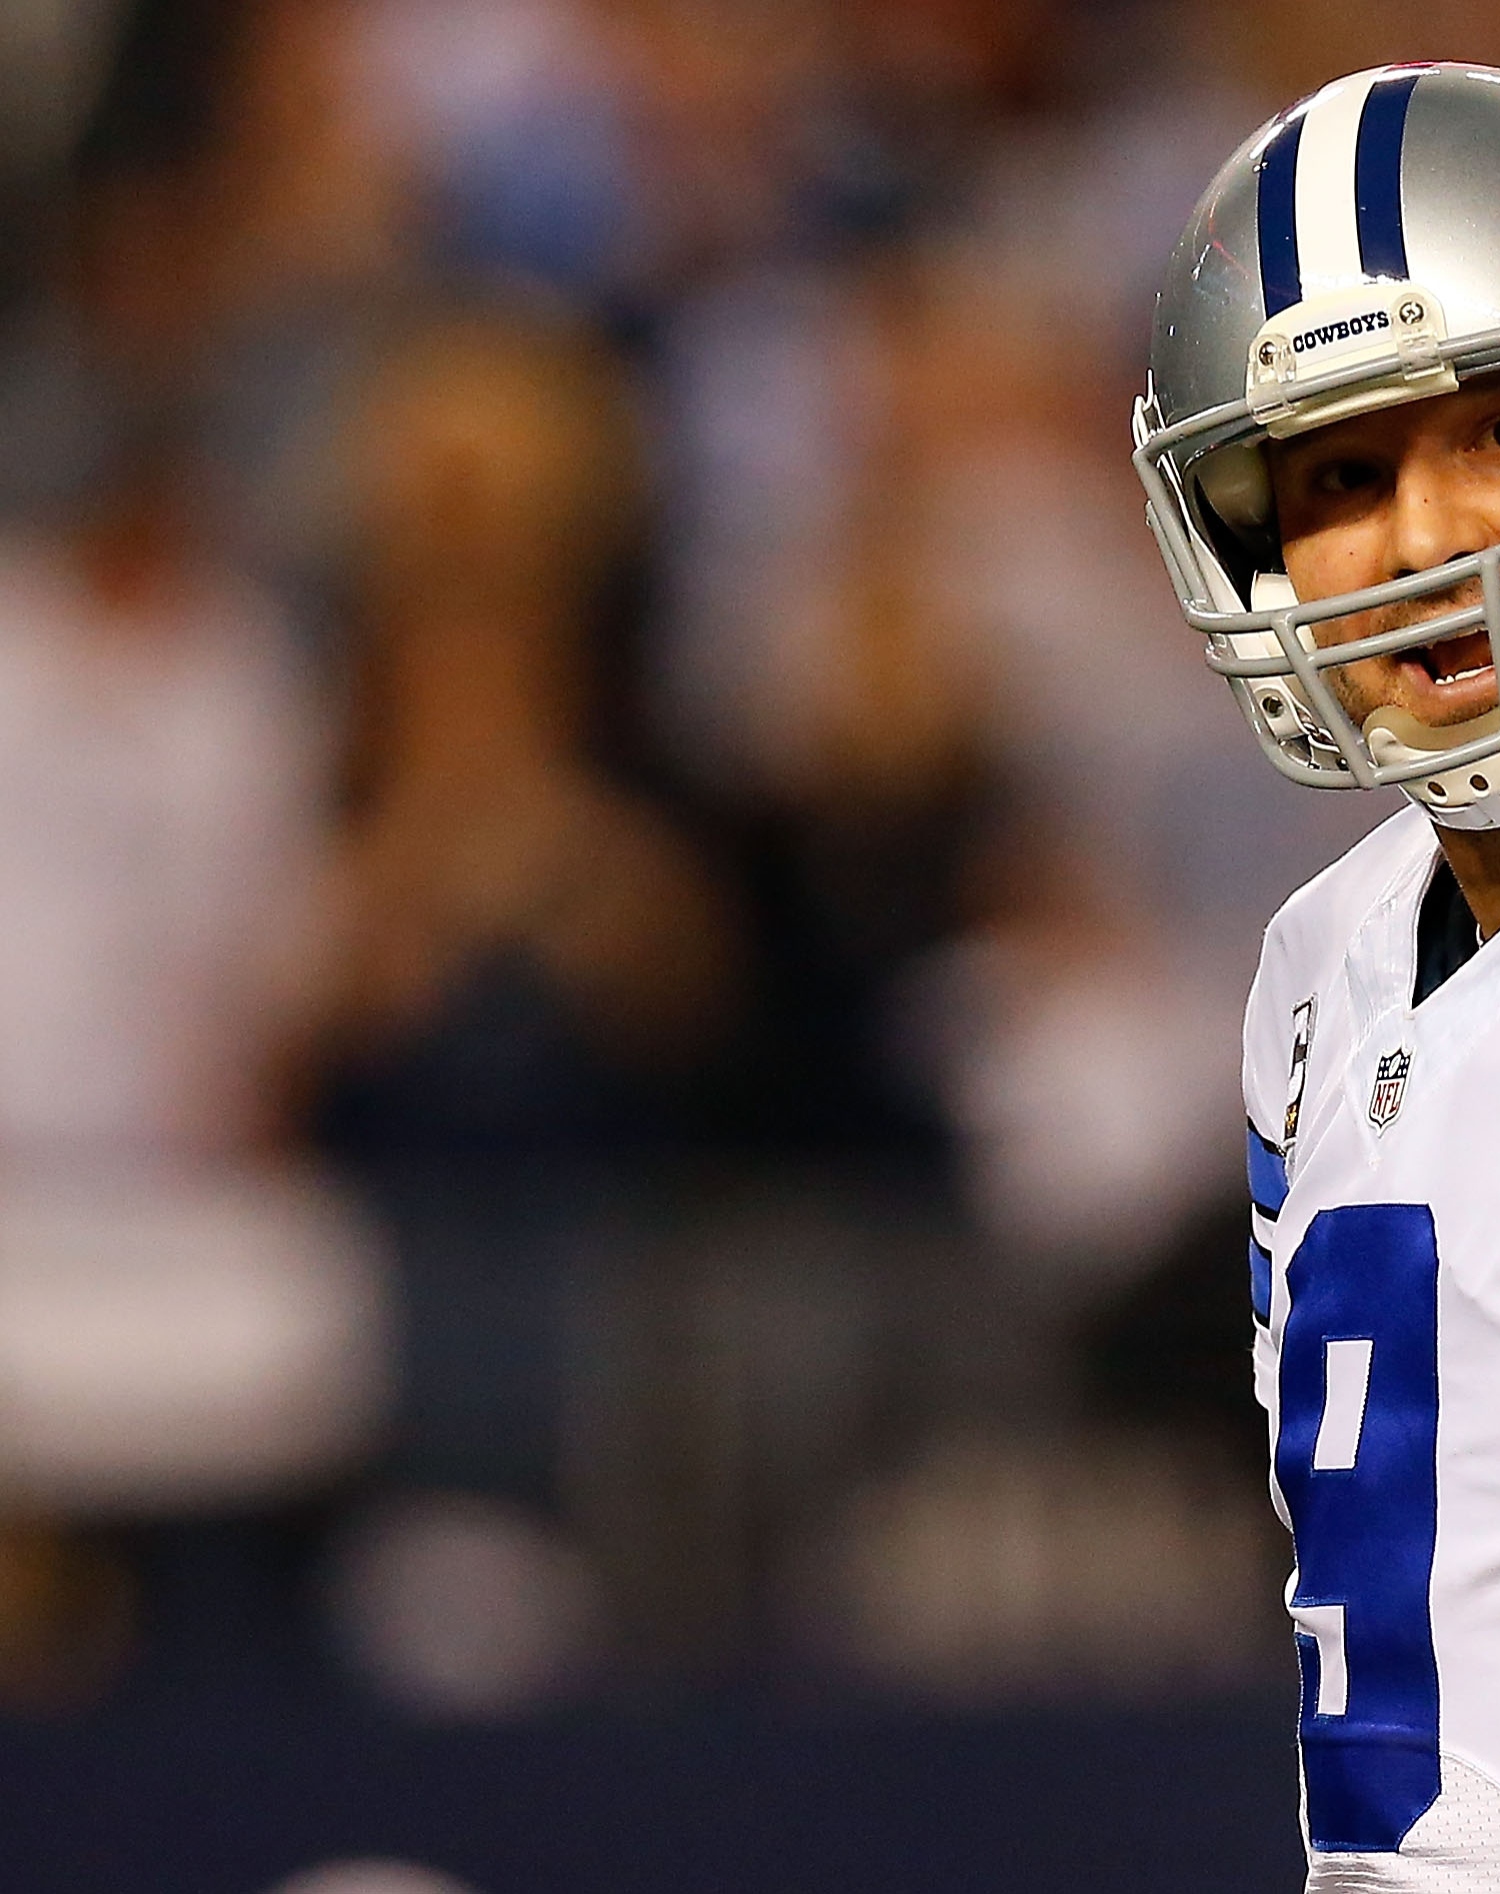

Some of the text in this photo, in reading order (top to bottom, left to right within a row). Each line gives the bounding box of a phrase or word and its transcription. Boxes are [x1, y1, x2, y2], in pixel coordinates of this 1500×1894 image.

[1293, 310, 1390, 353] COWBOYS
[1371, 1081, 1401, 1119] NFL
[1275, 1201, 1443, 1854] 9
